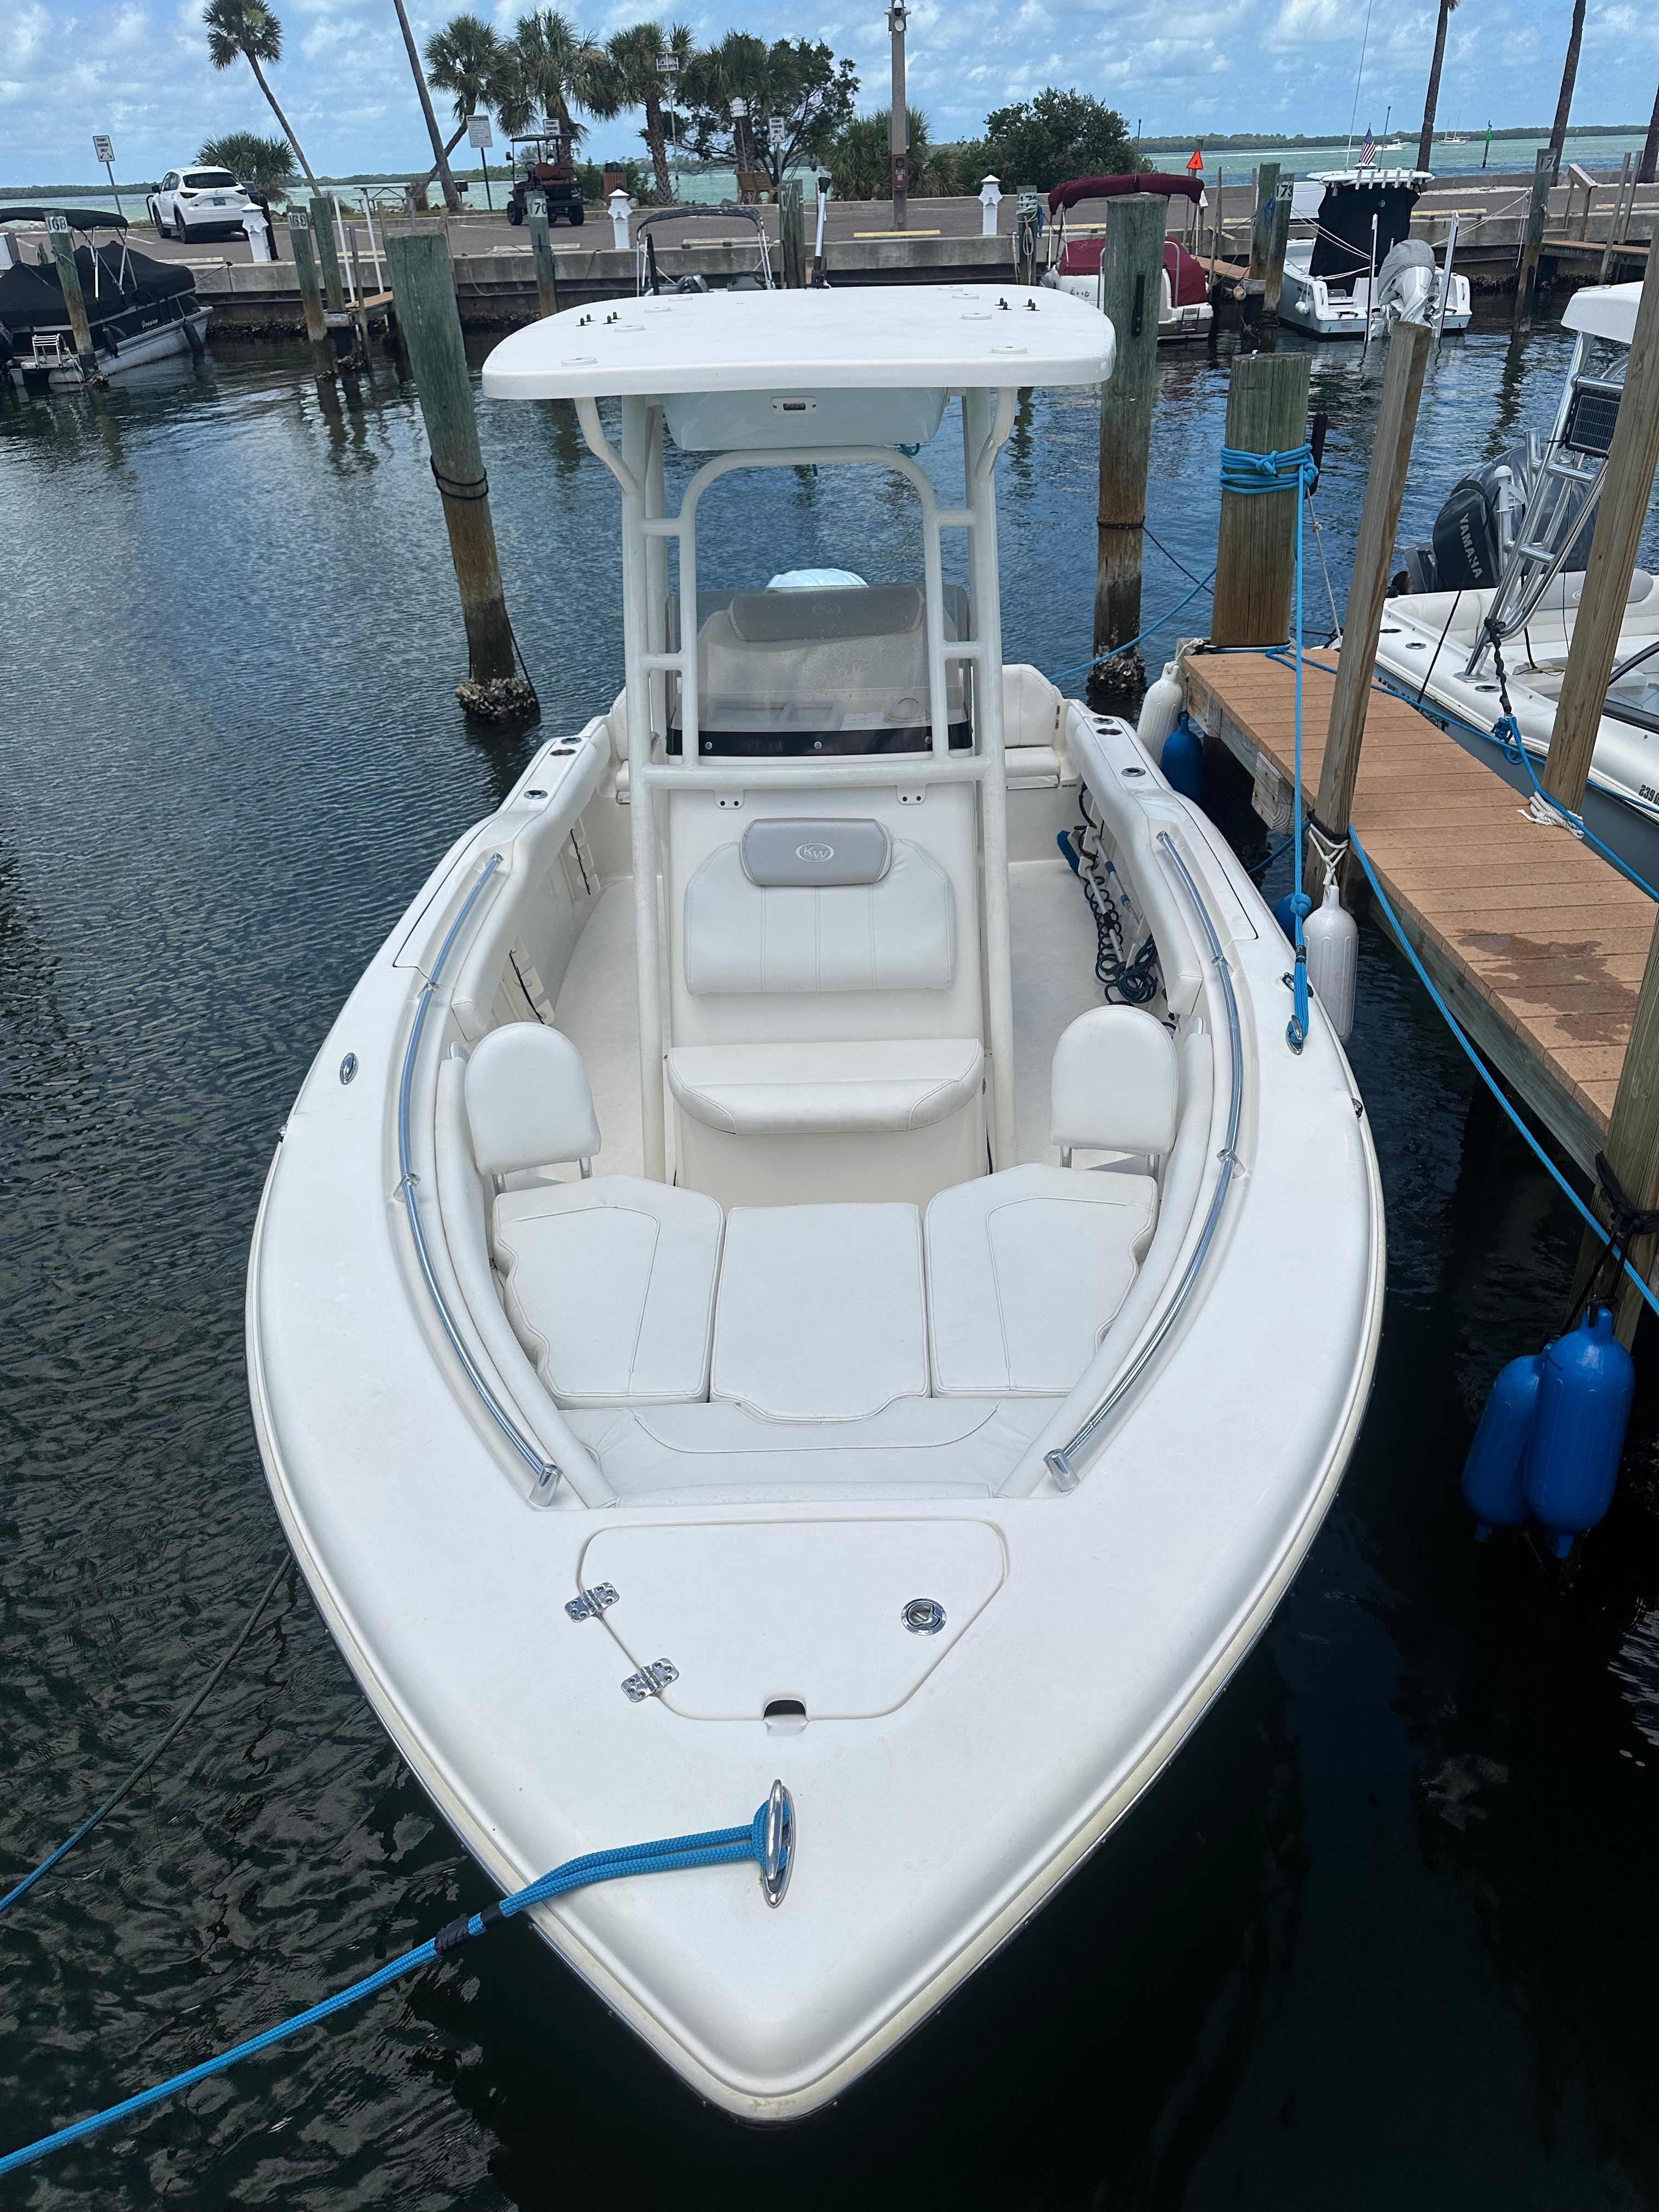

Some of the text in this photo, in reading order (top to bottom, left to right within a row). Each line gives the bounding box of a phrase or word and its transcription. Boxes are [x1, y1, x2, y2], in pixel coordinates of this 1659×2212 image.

[1276, 185, 1293, 198] 173
[529, 202, 548, 215] 170
[47, 217, 66, 230] 168
[289, 215, 307, 227] 169
[1460, 512, 1483, 579] YAMAHA
[1638, 784, 1656, 802] 239
[803, 847, 828, 858] KW
